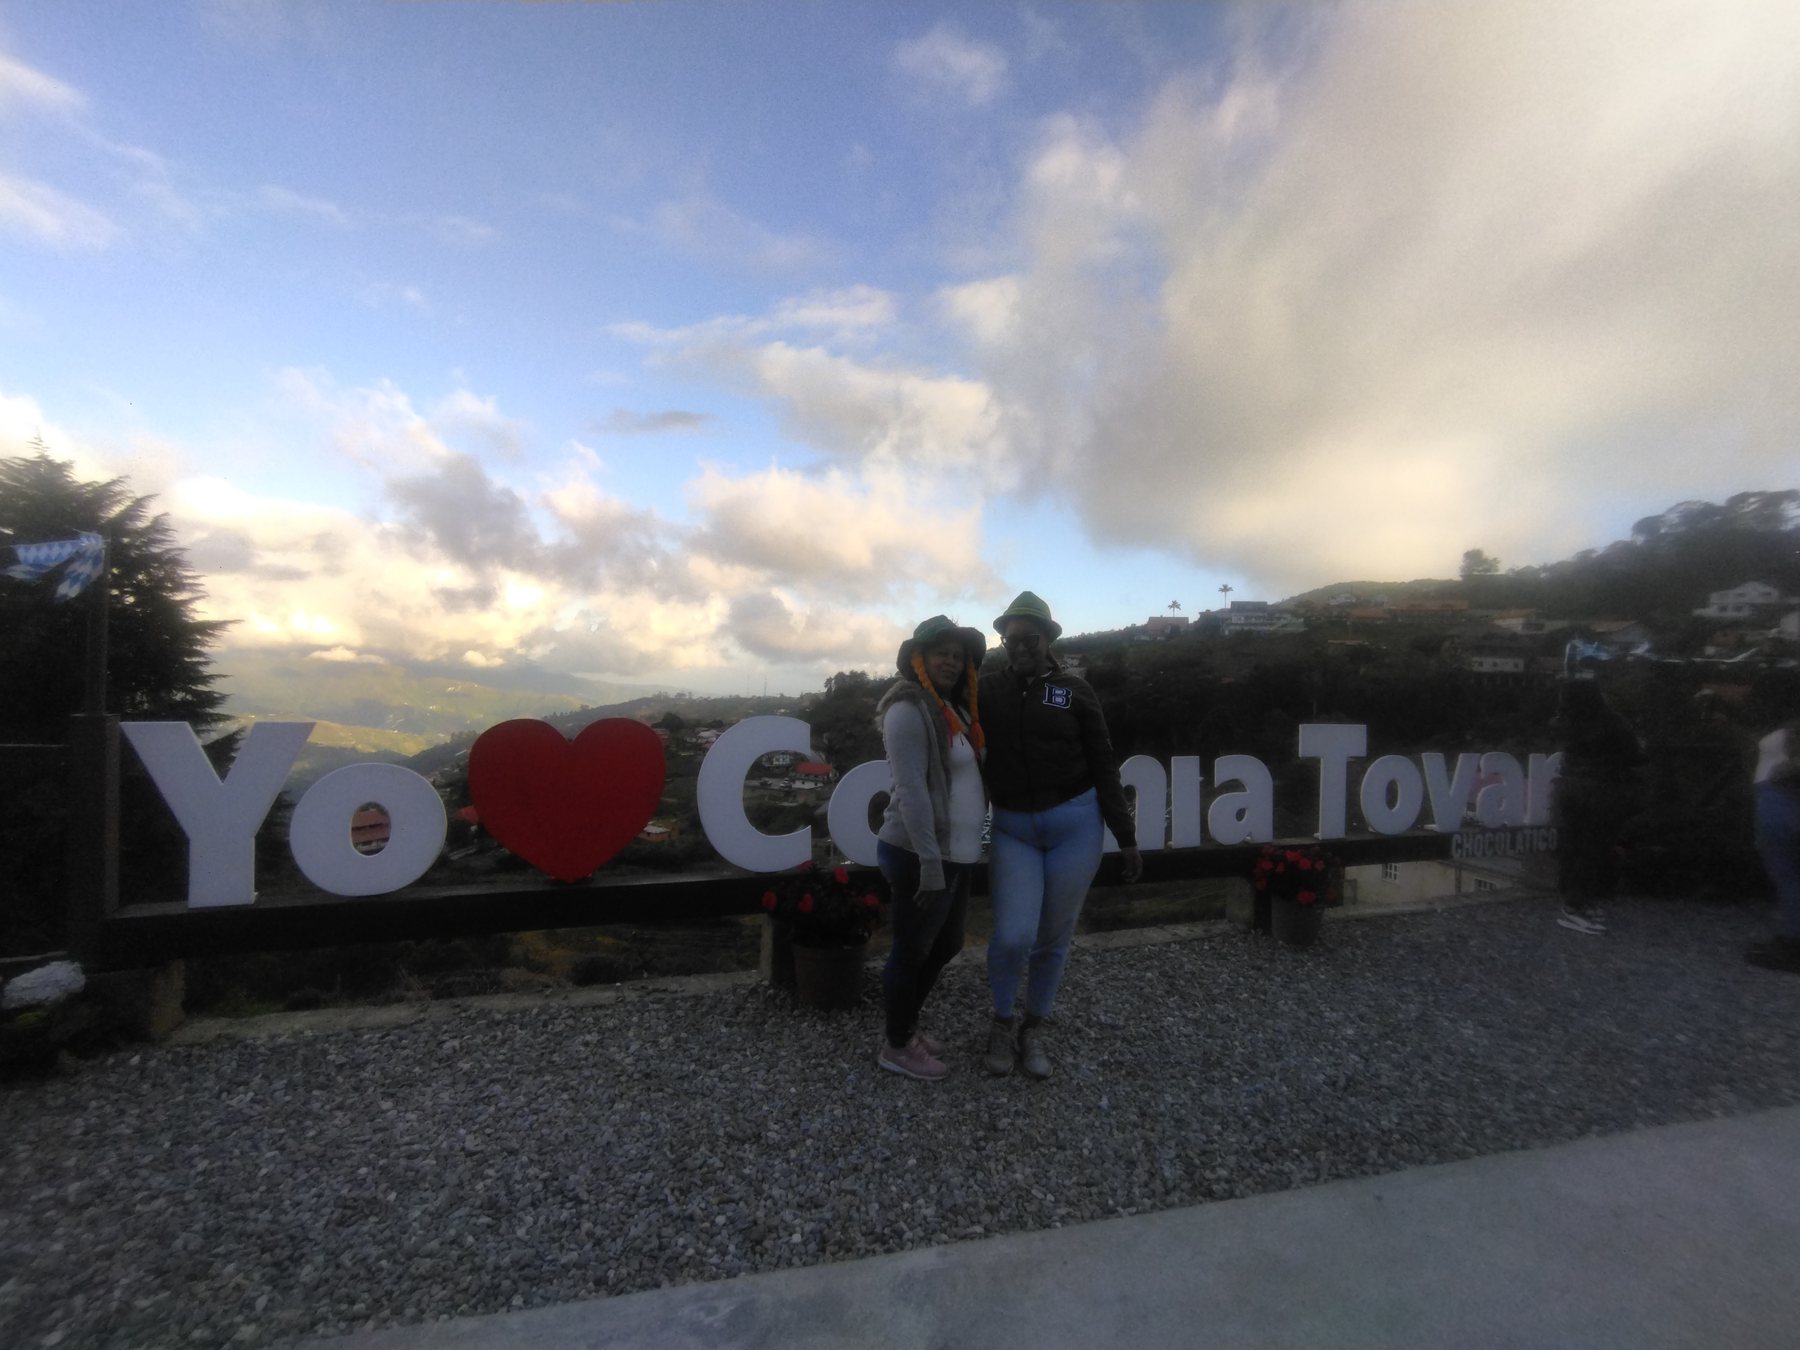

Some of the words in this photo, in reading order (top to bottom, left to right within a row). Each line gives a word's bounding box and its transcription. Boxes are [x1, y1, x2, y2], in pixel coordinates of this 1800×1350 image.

[1042, 682, 1073, 710] B
[119, 720, 448, 908] Yo
[697, 715, 1274, 873] Conia
[1298, 723, 1564, 840] Tovar
